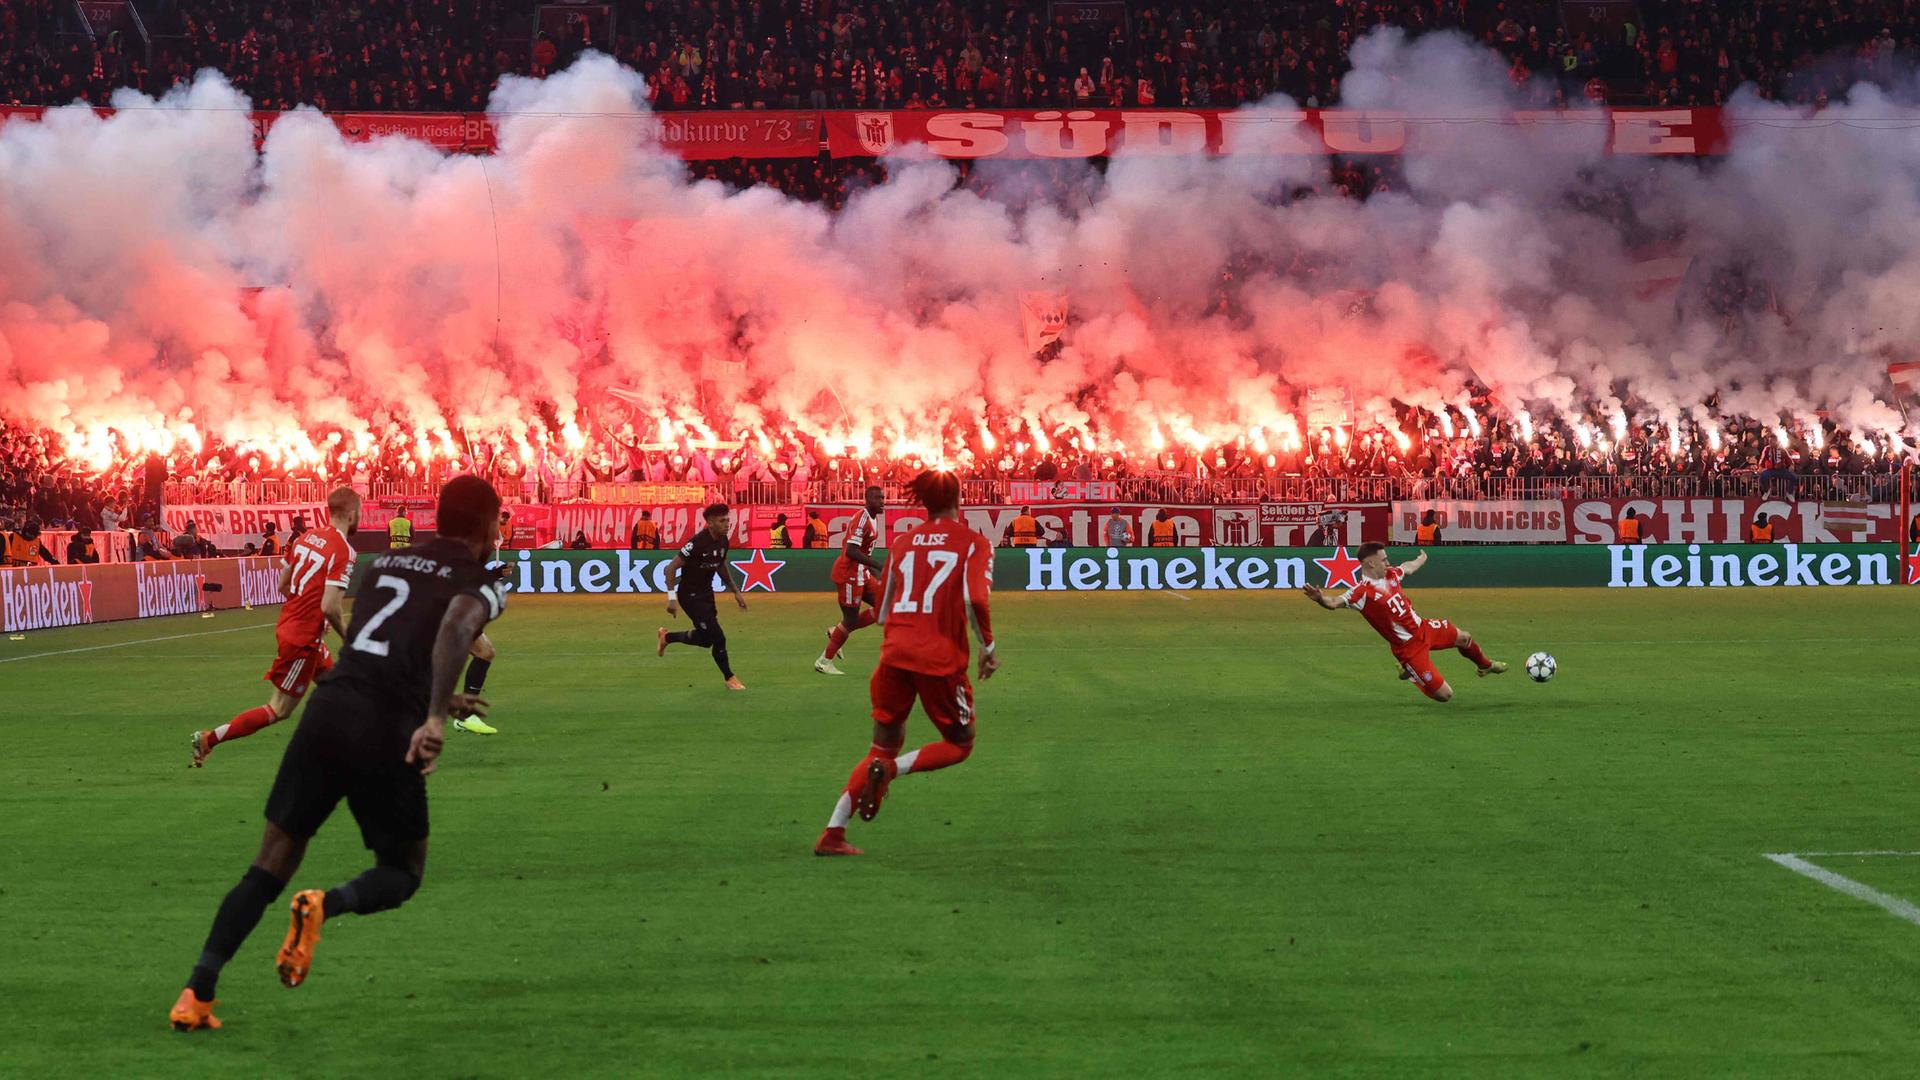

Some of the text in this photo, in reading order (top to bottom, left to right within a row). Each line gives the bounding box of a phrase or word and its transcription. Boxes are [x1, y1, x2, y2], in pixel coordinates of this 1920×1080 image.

[92, 9, 112, 20] 224
[911, 533, 949, 547] OLISE
[1607, 544, 1892, 588] Heineken
[135, 562, 197, 618] Heineken
[289, 543, 326, 597] 77
[892, 550, 959, 614] 17
[1025, 547, 1308, 590] Heineken
[1, 566, 81, 632] Heineken
[350, 574, 411, 658] 2
